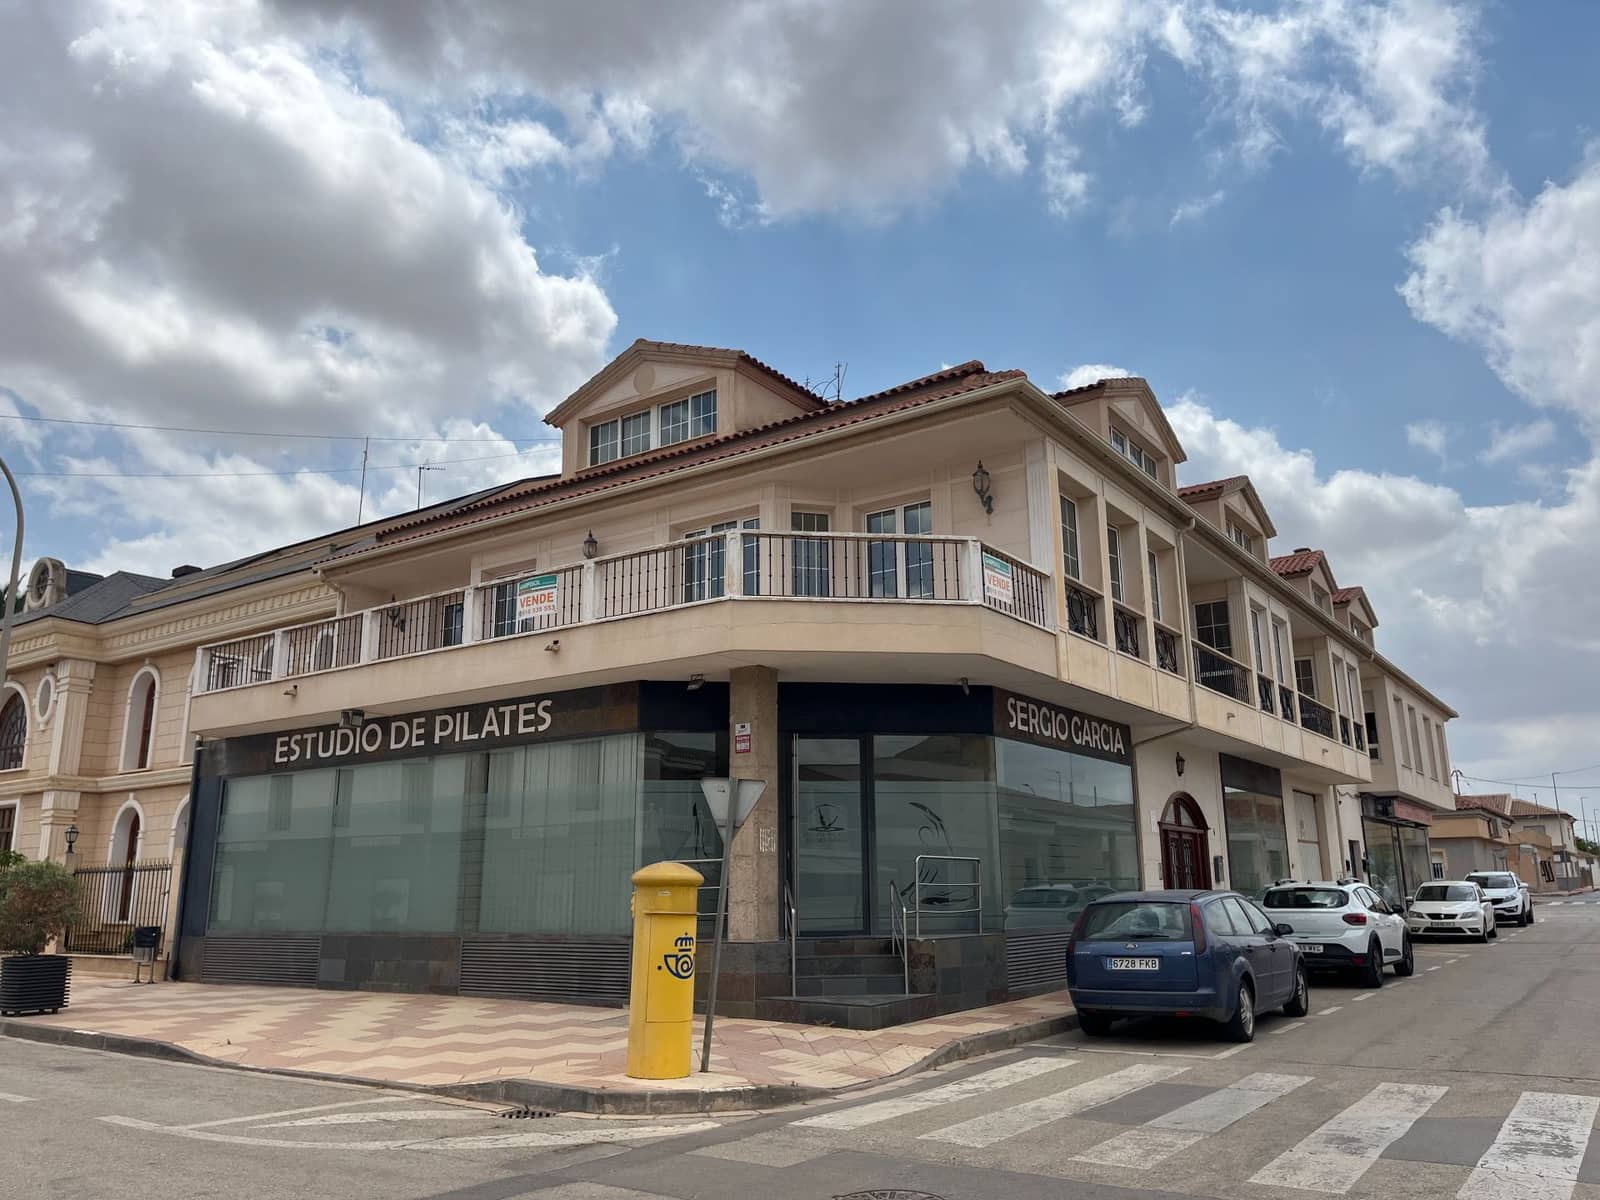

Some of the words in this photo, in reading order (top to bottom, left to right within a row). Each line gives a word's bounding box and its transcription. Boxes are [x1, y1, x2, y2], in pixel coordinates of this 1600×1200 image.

[987, 574, 1010, 591] VENDE
[520, 592, 554, 608] VENDE
[274, 723, 382, 763] ESTUDIO
[389, 717, 426, 750] DE
[433, 699, 553, 745] PILATES
[1007, 697, 1069, 741] SERGIO
[1071, 716, 1125, 755] GARCIA
[1113, 959, 1136, 969] 6728
[1139, 959, 1157, 969] FKB
